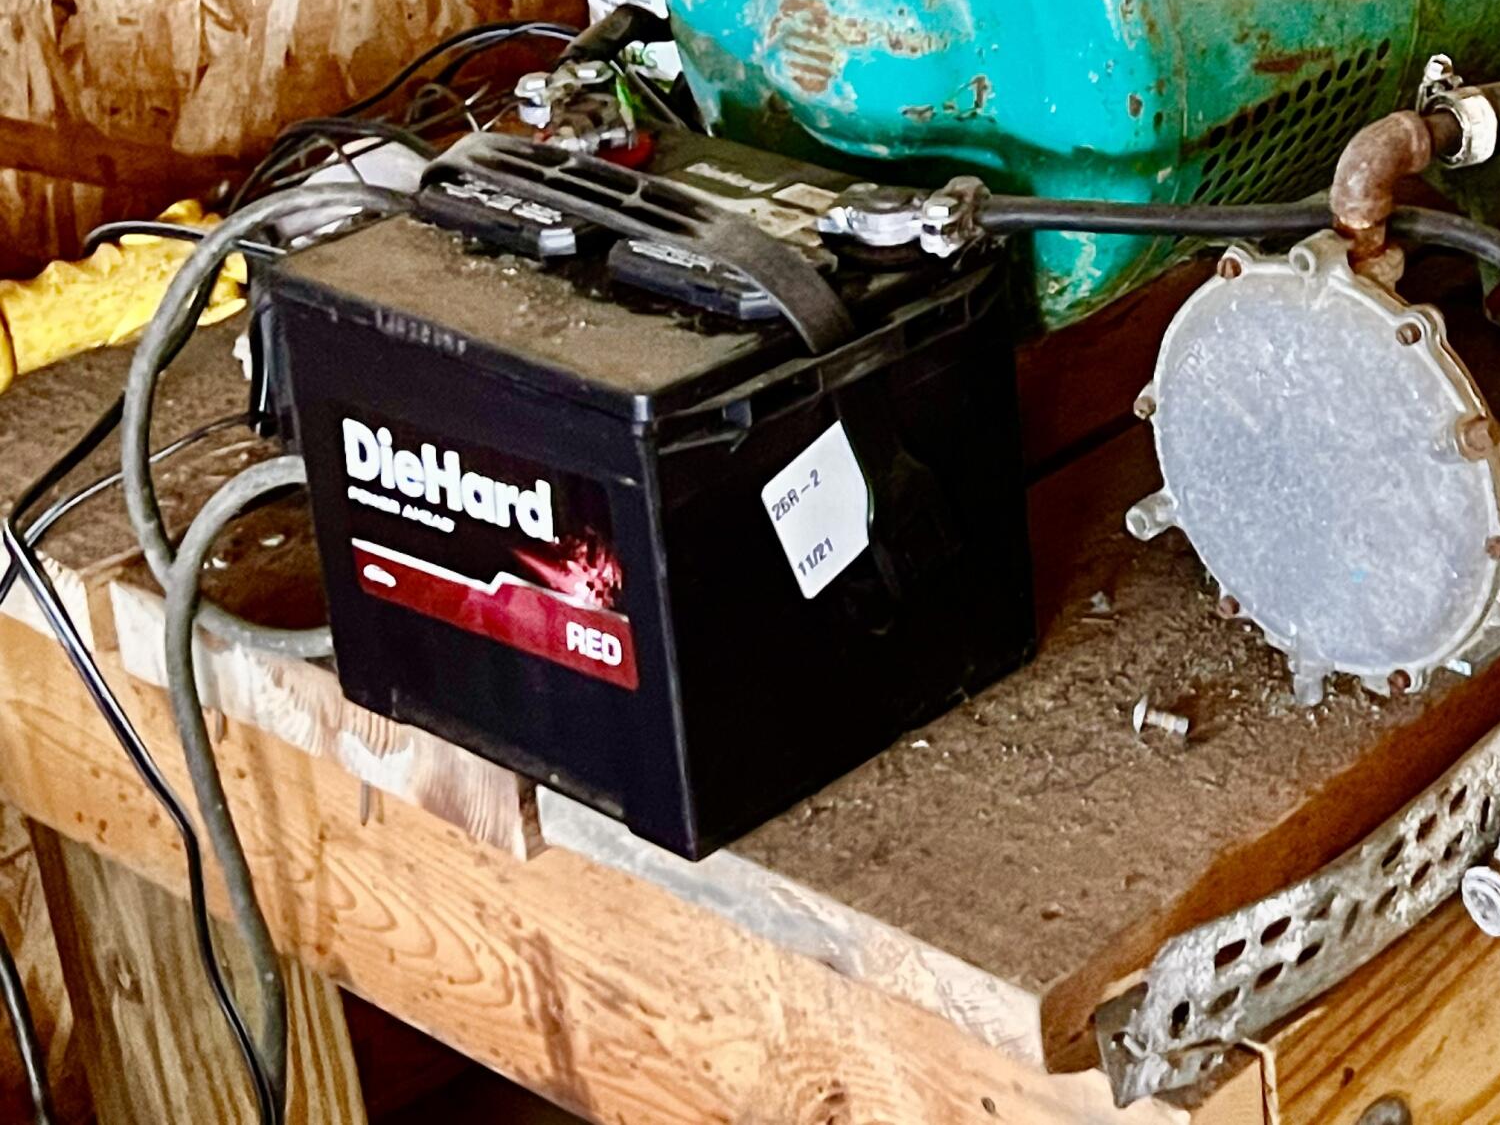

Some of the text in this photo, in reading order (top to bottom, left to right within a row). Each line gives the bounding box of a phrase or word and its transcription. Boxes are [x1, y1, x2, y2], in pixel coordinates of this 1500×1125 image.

[342, 417, 553, 543] DieHard
[796, 536, 834, 577] 11/21
[565, 621, 622, 667] RED
